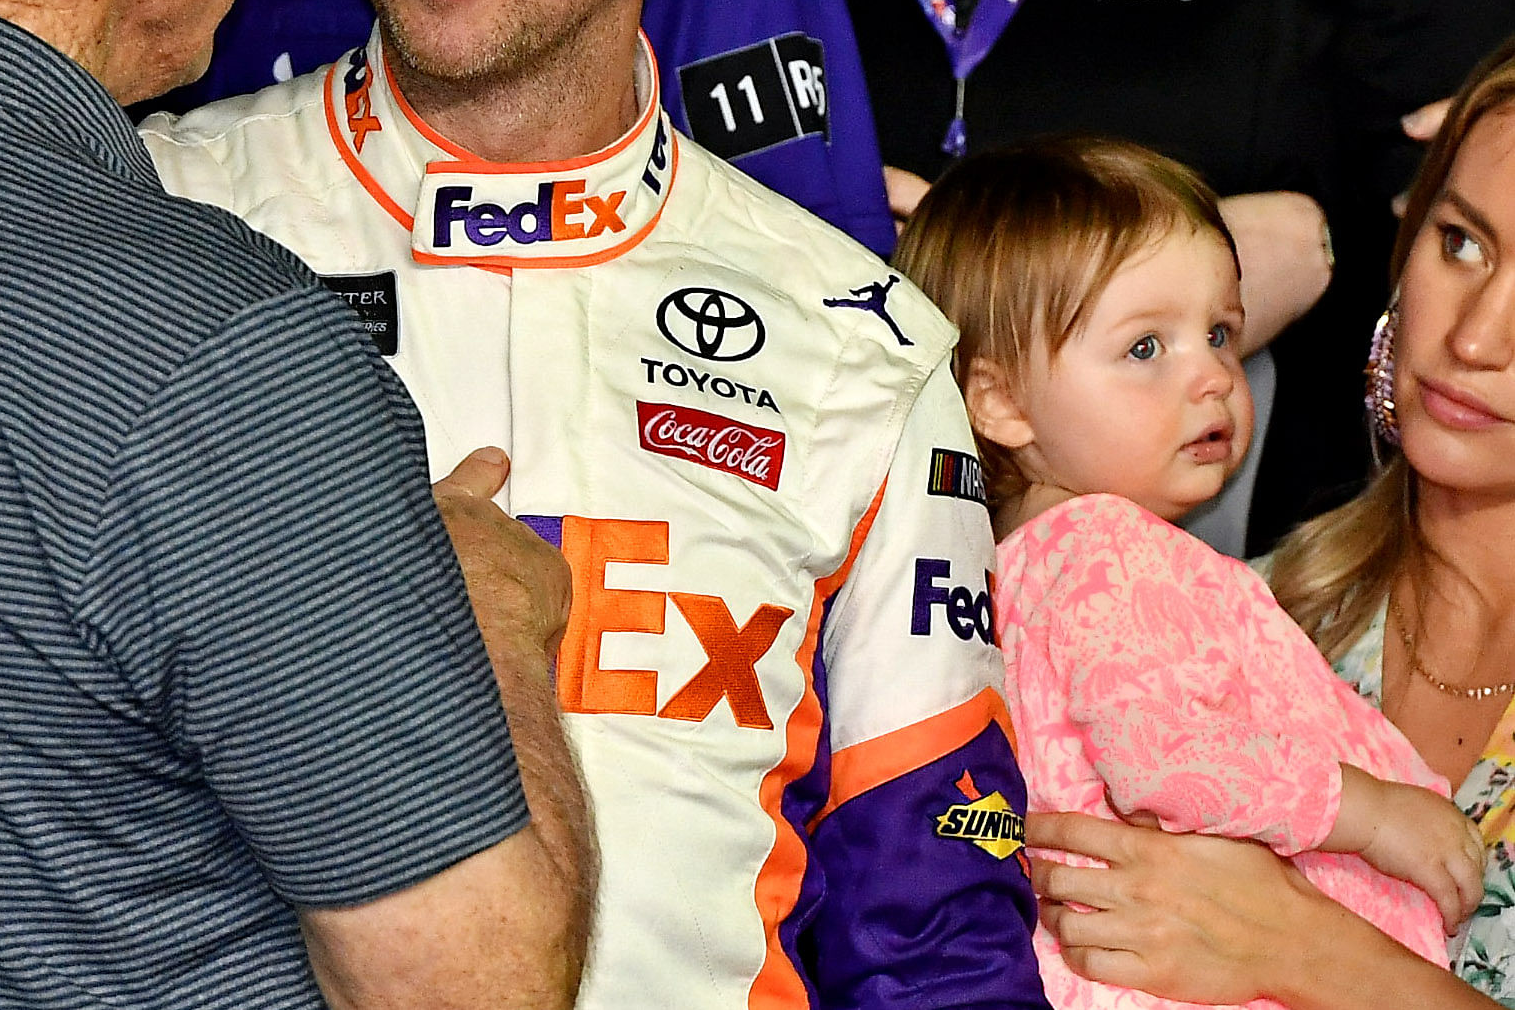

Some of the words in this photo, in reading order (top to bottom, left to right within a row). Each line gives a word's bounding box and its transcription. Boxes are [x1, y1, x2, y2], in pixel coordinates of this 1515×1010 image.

[710, 75, 765, 132] 11
[433, 179, 627, 248] FedEx
[641, 358, 781, 414] TOYOTA
[644, 410, 782, 480] Coca-Cola
